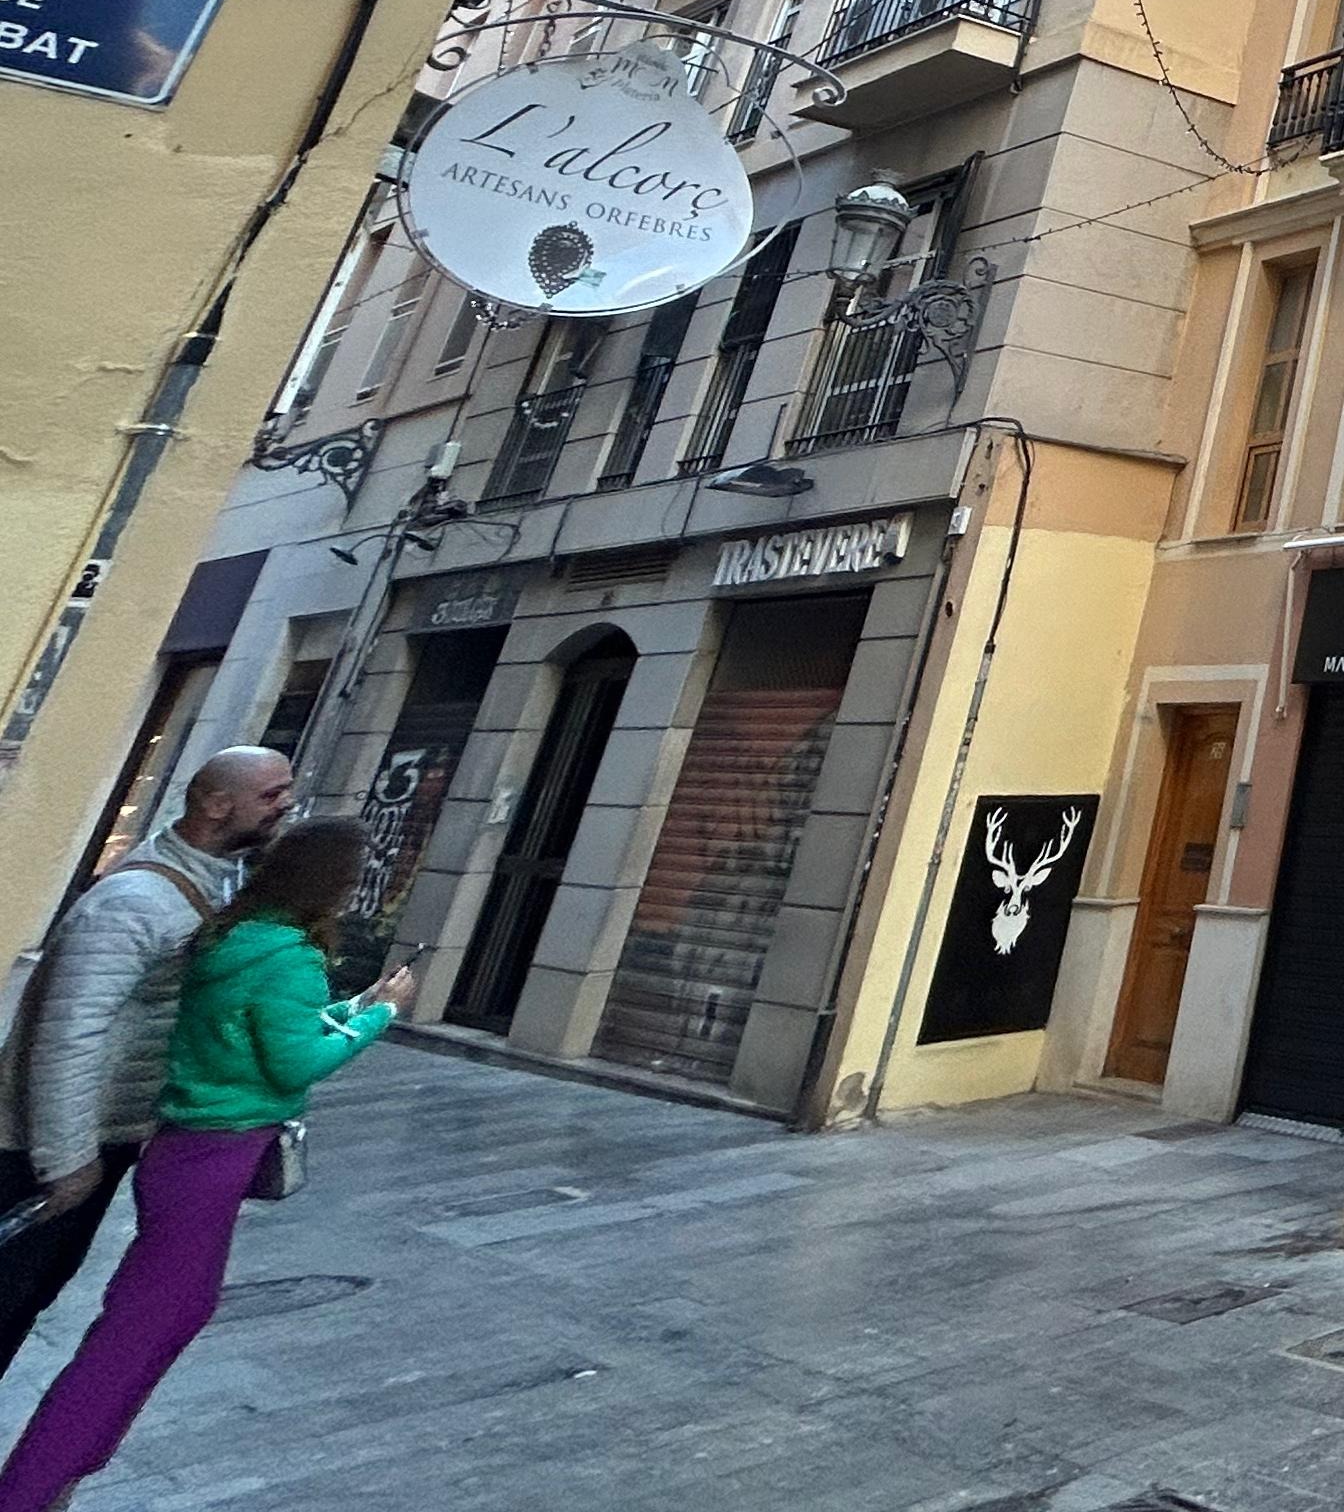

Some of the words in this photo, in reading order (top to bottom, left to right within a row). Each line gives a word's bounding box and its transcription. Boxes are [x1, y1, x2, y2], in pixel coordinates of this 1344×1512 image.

[441, 162, 572, 212] ARTESANS
[586, 202, 713, 242] ORFEBRES
[459, 104, 729, 221] L'alcorç
